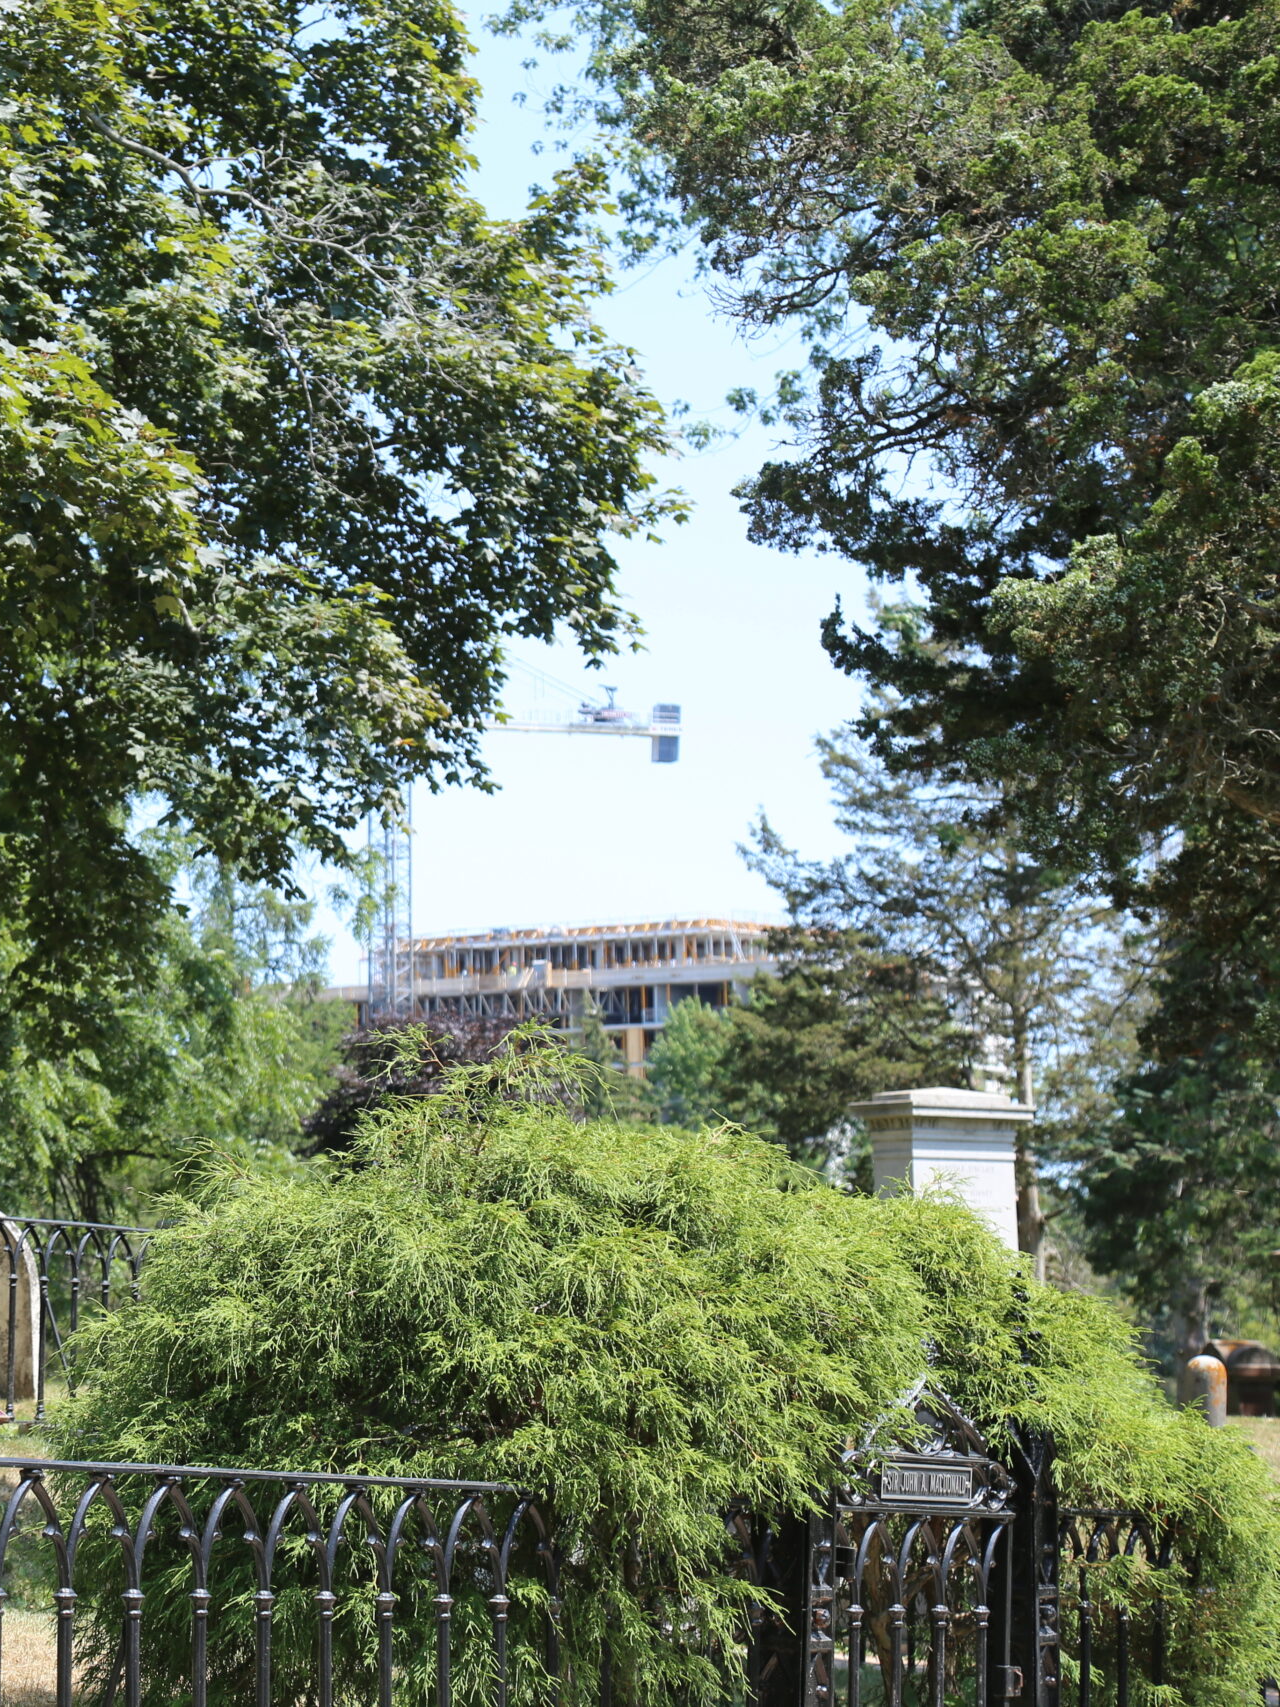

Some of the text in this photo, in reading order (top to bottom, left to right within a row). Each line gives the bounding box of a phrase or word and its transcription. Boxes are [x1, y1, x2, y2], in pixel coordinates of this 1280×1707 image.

[886, 1471, 967, 1494] SIR JOHN A. MACDONALD
